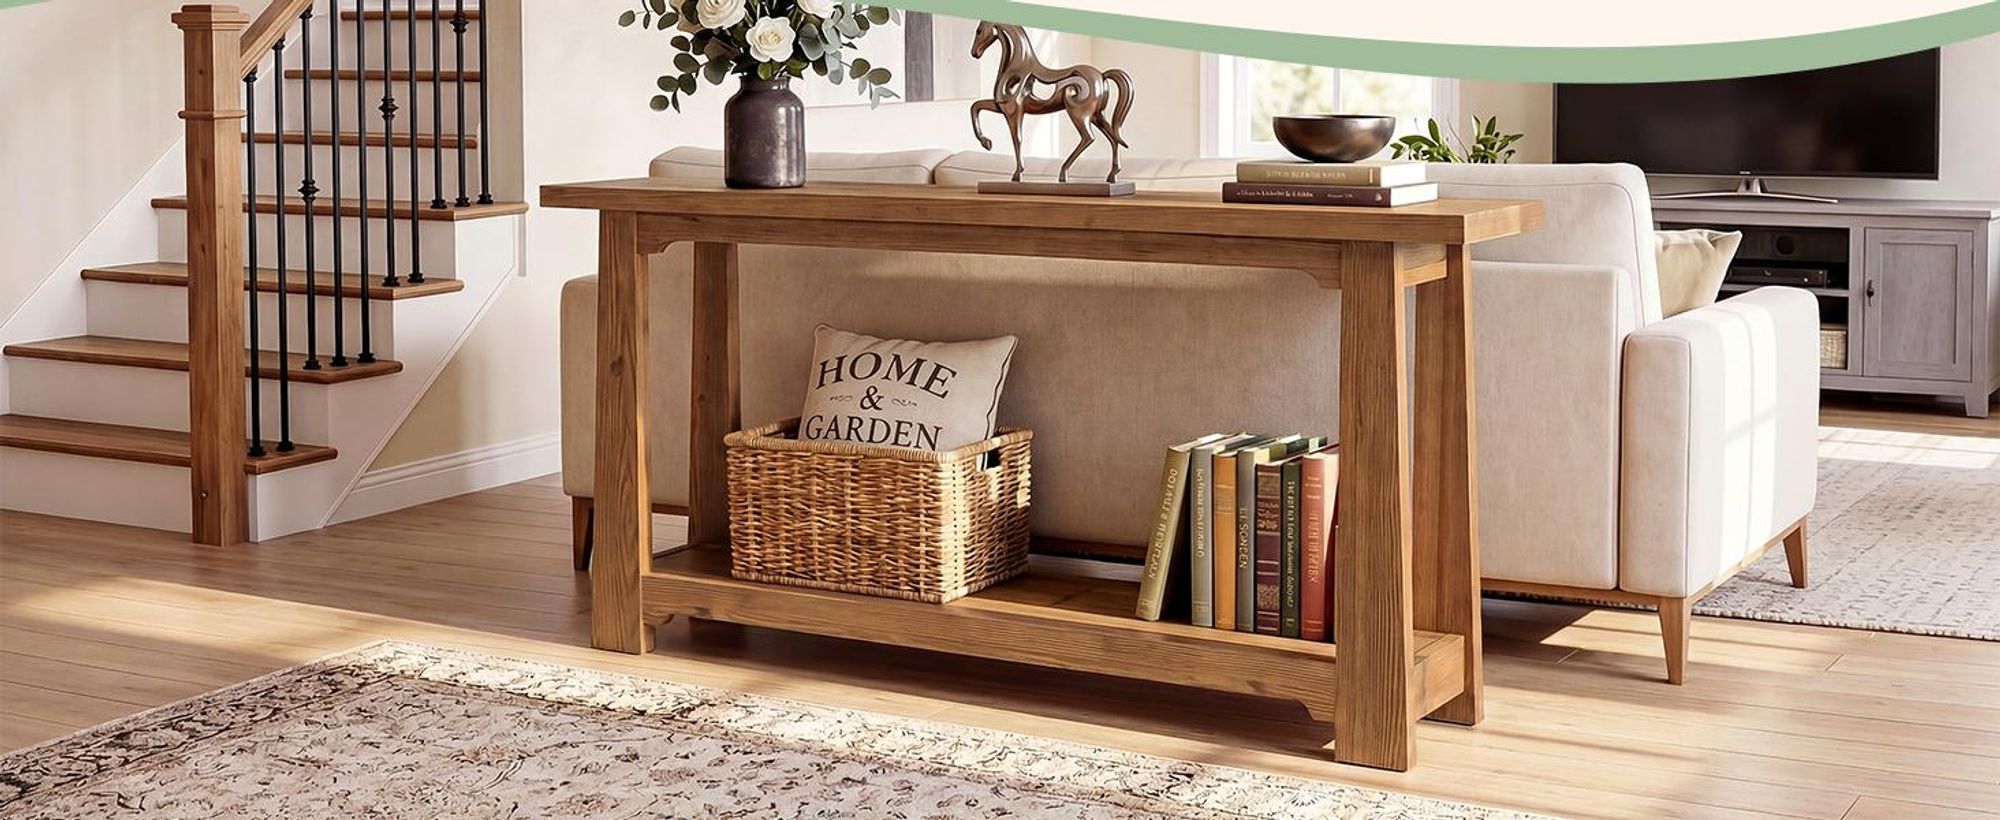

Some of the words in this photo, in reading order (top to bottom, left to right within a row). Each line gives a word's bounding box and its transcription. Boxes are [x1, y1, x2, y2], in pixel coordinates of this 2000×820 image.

[816, 351, 958, 399] HOME
[859, 385, 885, 411] &
[805, 414, 943, 451] GARDEN
